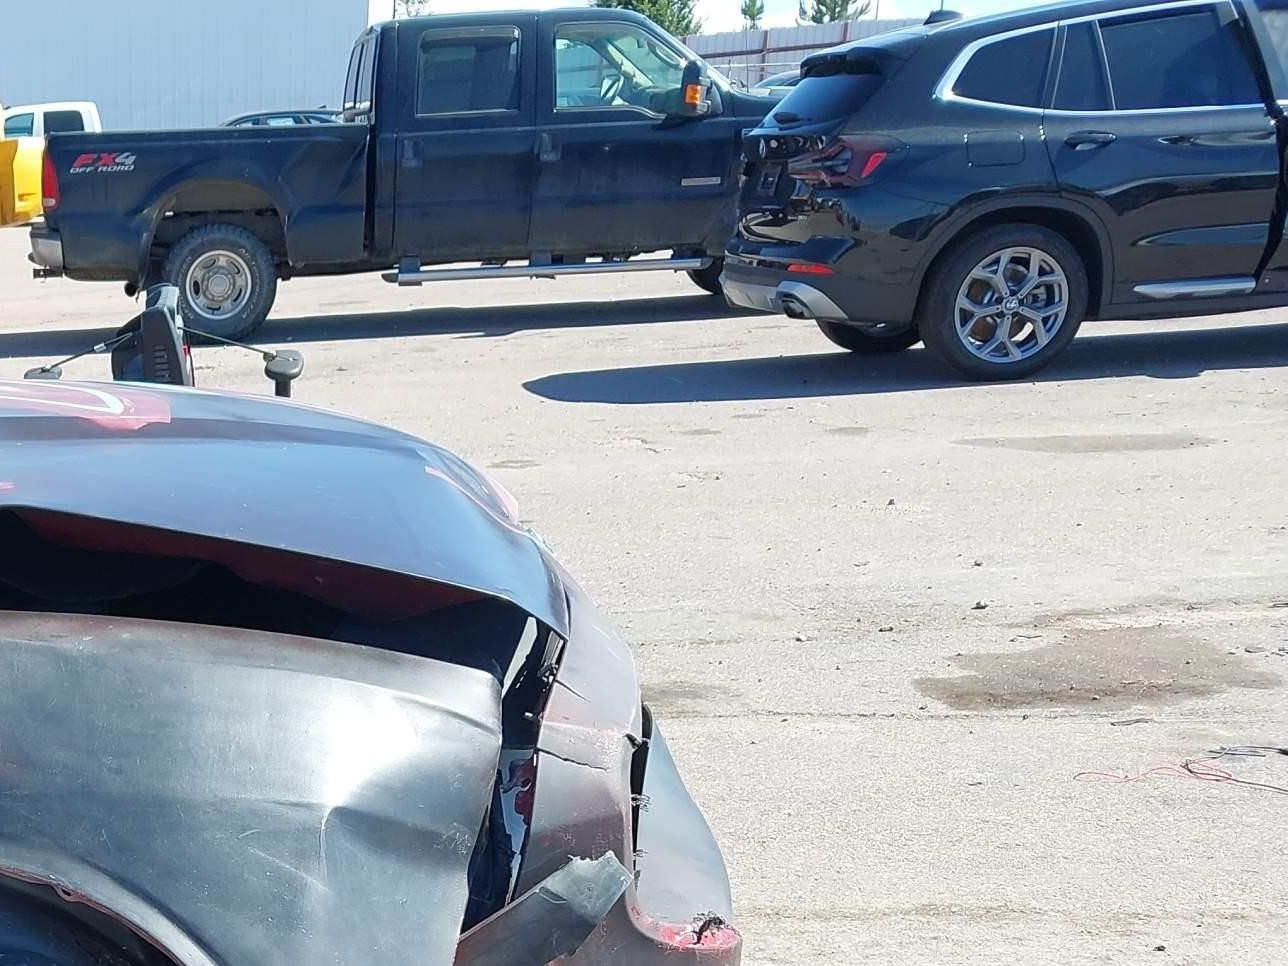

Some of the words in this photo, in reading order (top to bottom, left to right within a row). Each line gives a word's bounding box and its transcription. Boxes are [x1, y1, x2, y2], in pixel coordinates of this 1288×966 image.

[72, 152, 136, 167] FX4
[69, 166, 96, 174] OFF
[97, 165, 135, 173] ROAD
